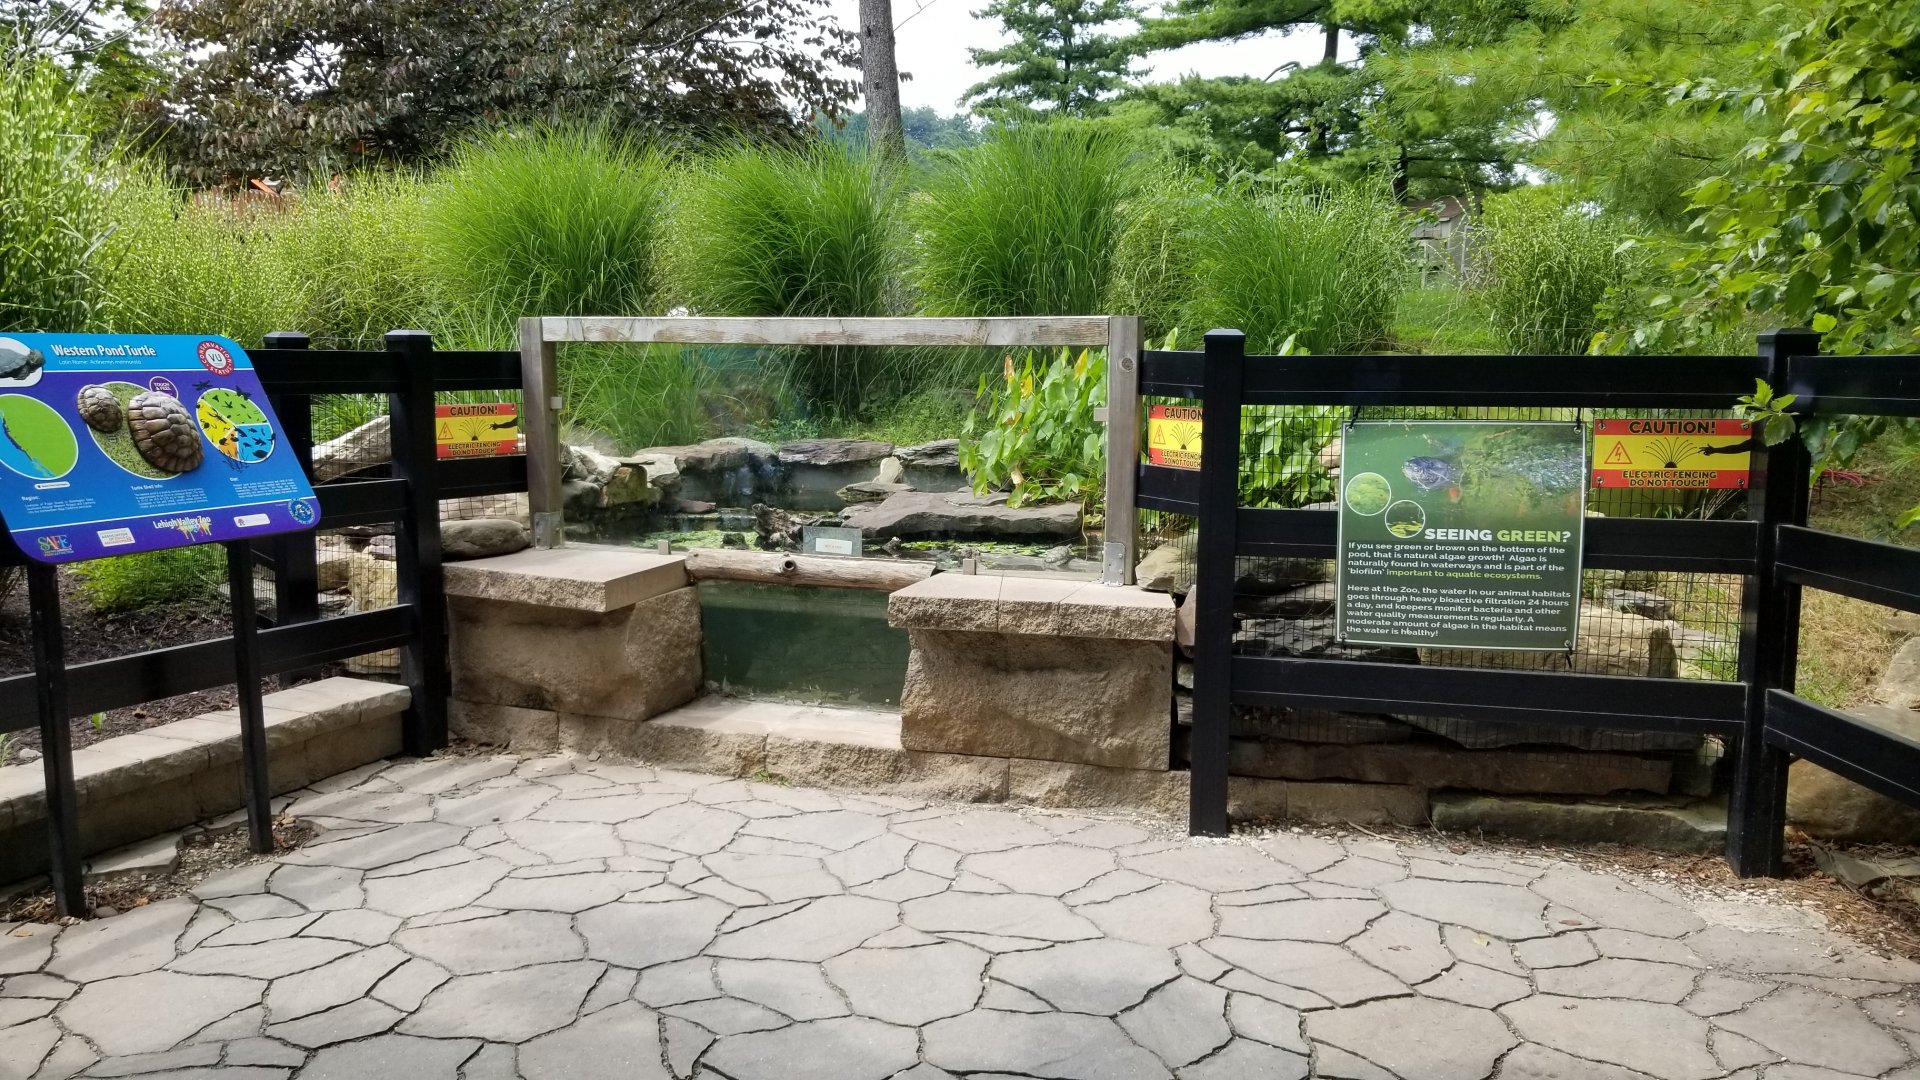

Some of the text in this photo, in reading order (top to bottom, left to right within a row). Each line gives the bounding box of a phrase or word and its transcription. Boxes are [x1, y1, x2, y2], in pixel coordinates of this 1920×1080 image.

[51, 344, 156, 356] Western Pond Turtle
[208, 354, 222, 362] VU
[450, 406, 498, 416] CAUTION!
[1629, 421, 1716, 434] CAUTION!
[153, 516, 211, 529] Lehigh Valley Zoo
[1424, 528, 1571, 542] SEEING GREEN?
[38, 534, 72, 551] SAFE
[1431, 562, 1481, 570] waterways
[1371, 594, 1408, 602] through
[1410, 595, 1437, 603] heavy
[1401, 628, 1438, 637] healthy!
